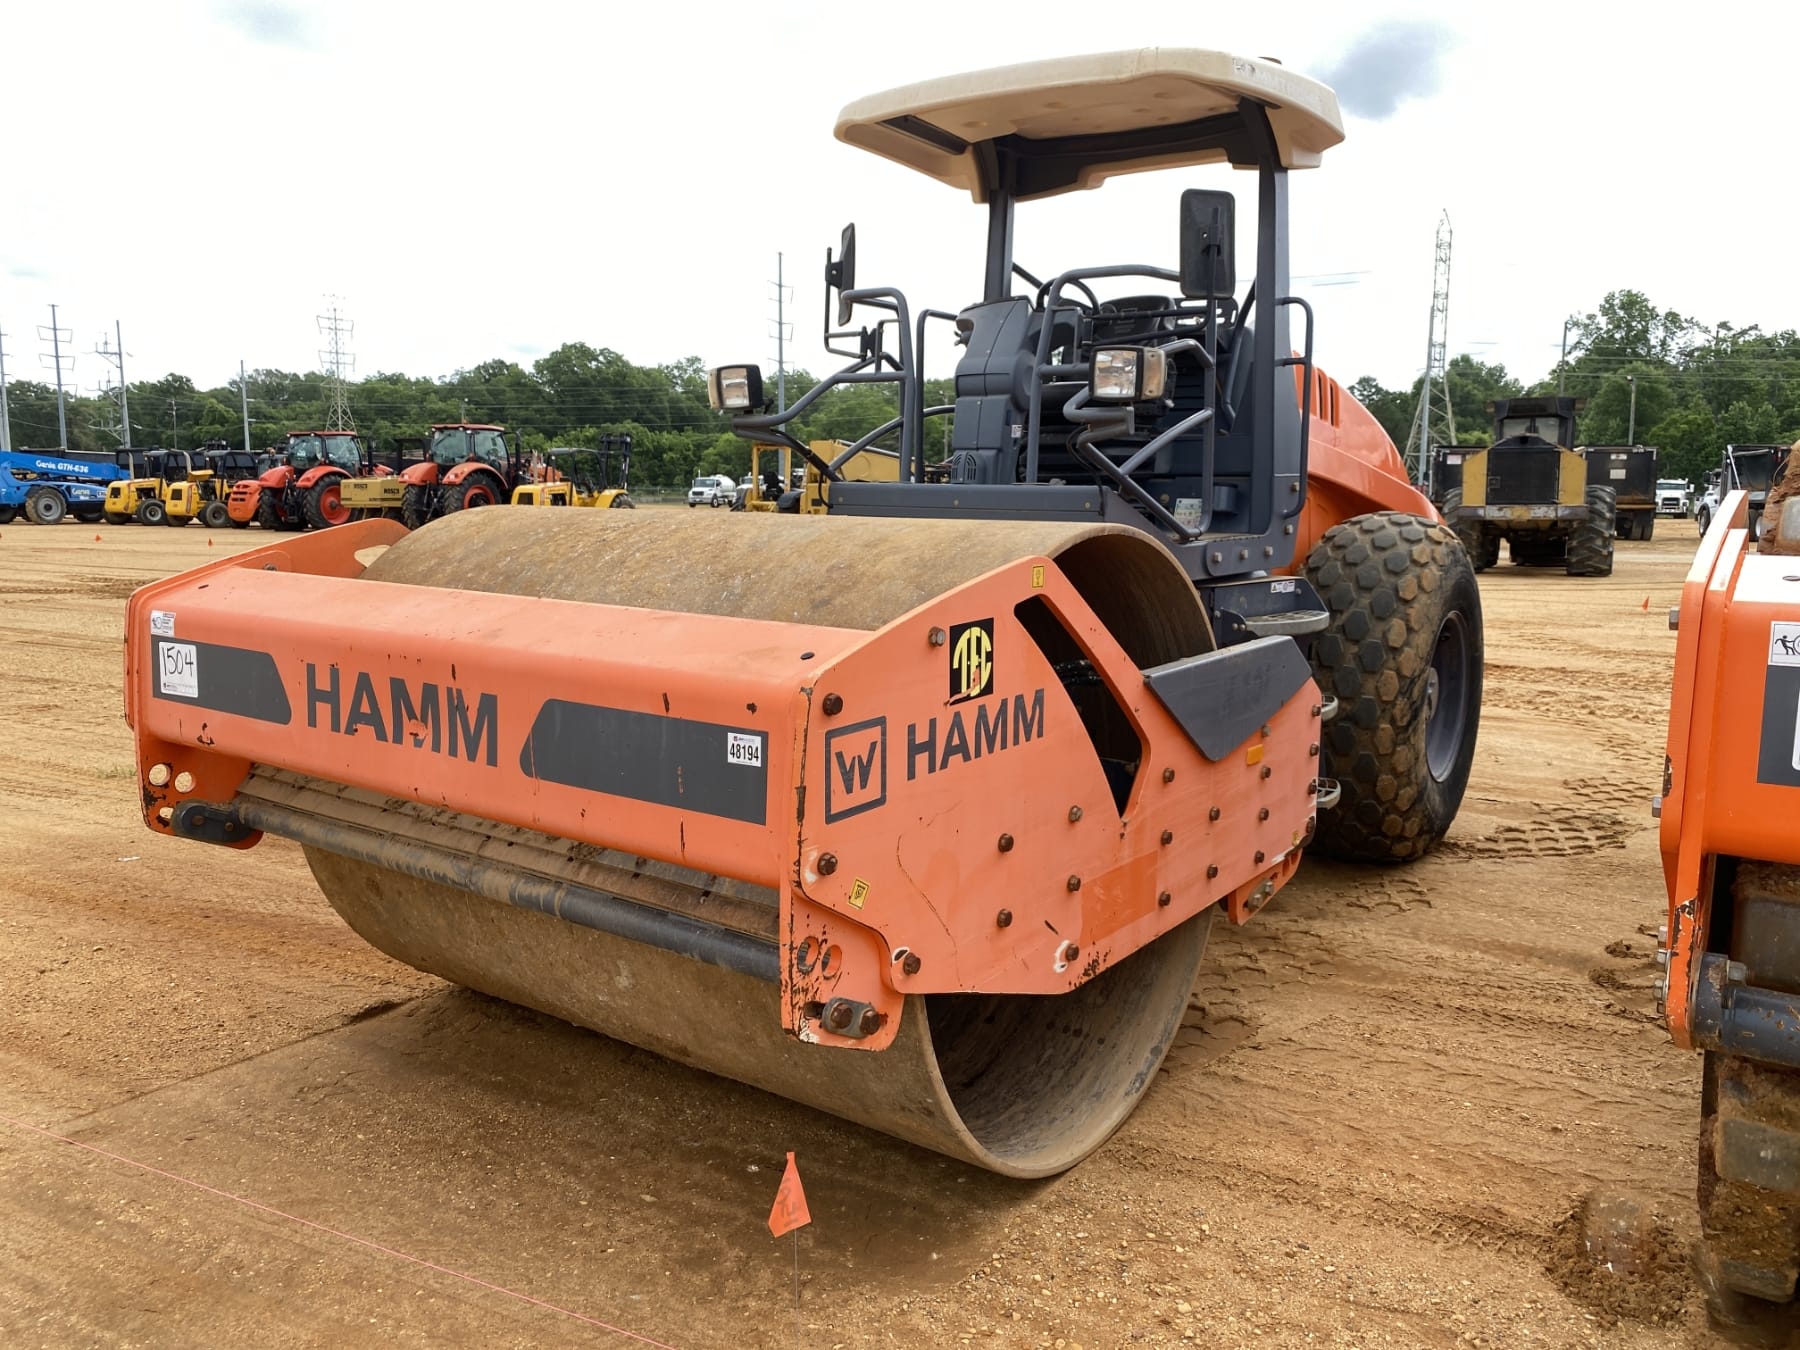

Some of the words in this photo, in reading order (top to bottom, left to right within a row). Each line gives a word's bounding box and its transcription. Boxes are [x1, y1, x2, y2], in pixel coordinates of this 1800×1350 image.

[35, 460, 56, 469] Genie
[161, 646, 194, 677] 1504
[306, 662, 498, 768] HAMM
[907, 688, 1044, 781] HAMM
[729, 743, 759, 762] 48194
